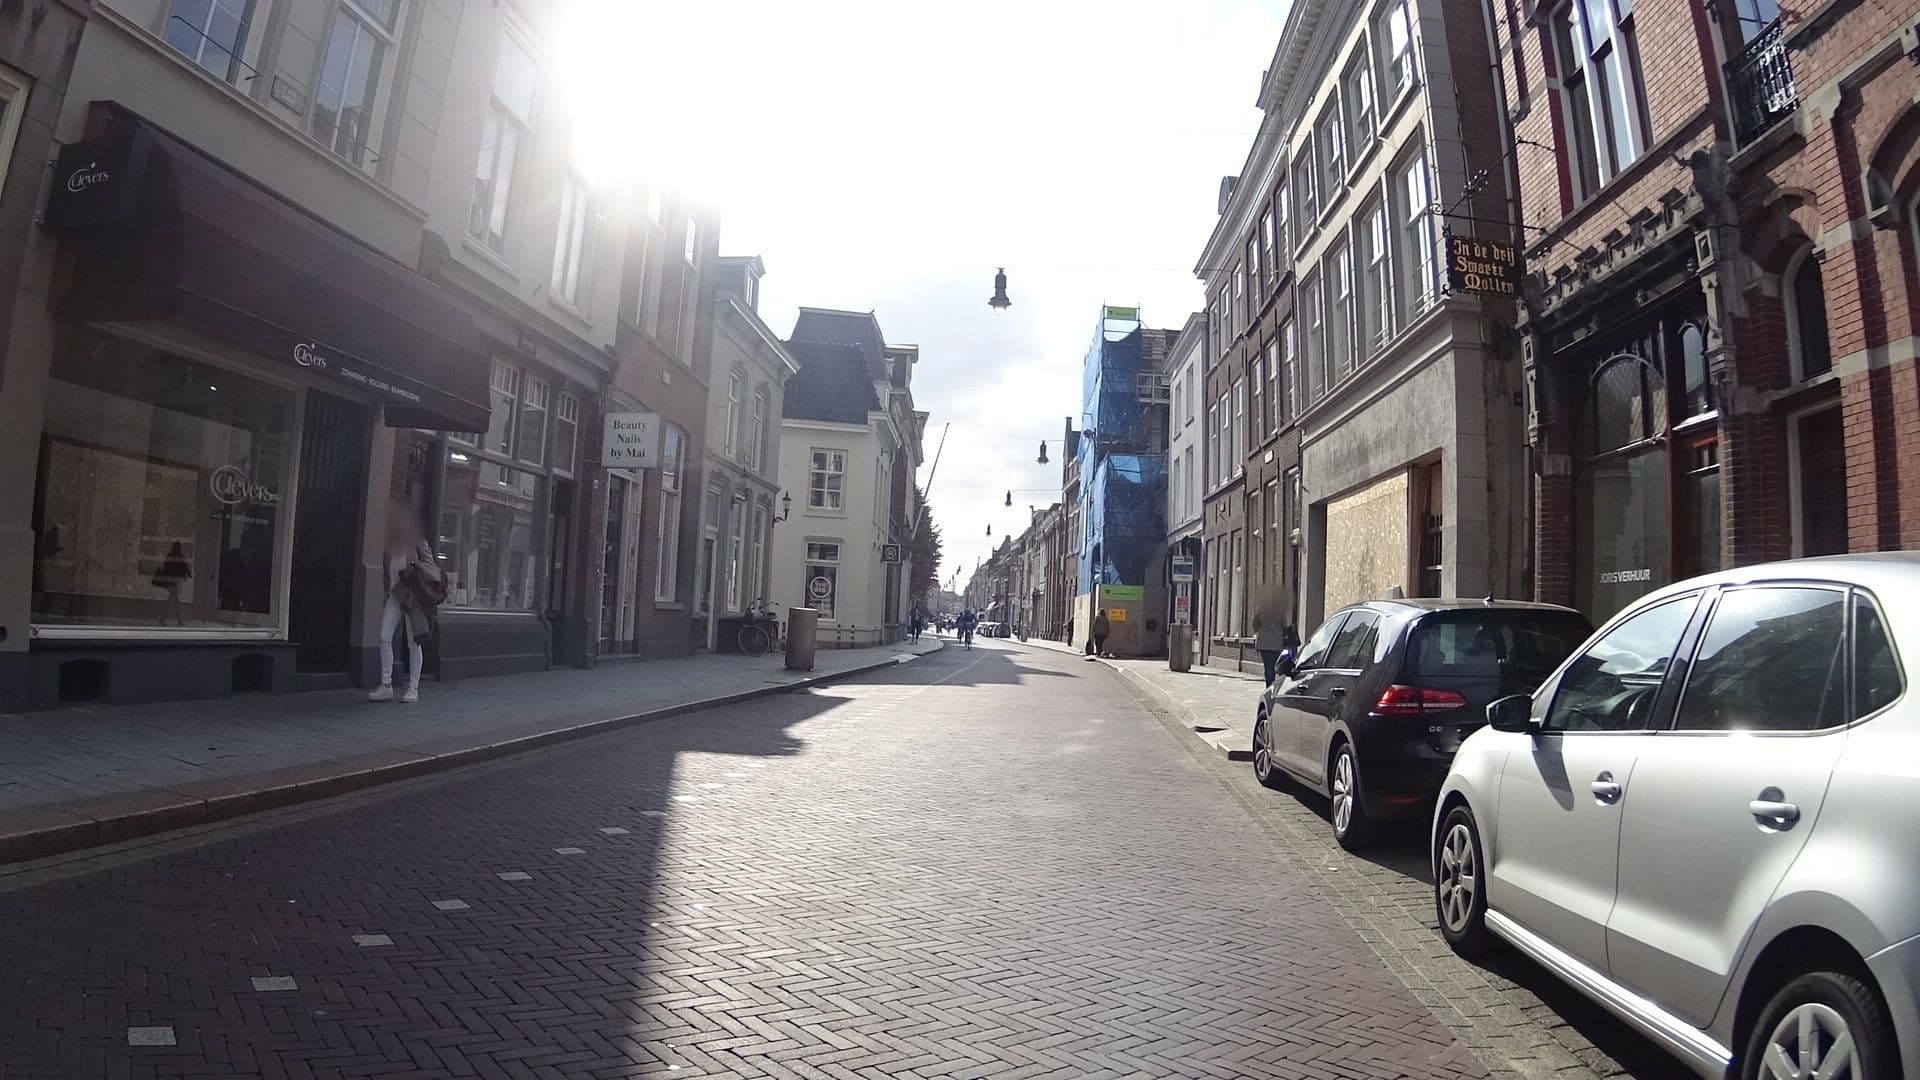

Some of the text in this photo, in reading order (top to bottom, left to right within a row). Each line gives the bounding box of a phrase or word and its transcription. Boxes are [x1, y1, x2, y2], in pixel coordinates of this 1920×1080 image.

[67, 162, 109, 192] Clevers
[1453, 239, 1470, 257] In
[1472, 241, 1488, 259] de
[1464, 273, 1514, 294] Mollen
[293, 343, 327, 368] Clevers
[613, 420, 648, 432] Beauty
[616, 433, 641, 444] Nails
[610, 447, 646, 460] by Mai
[210, 465, 273, 504] Clevers
